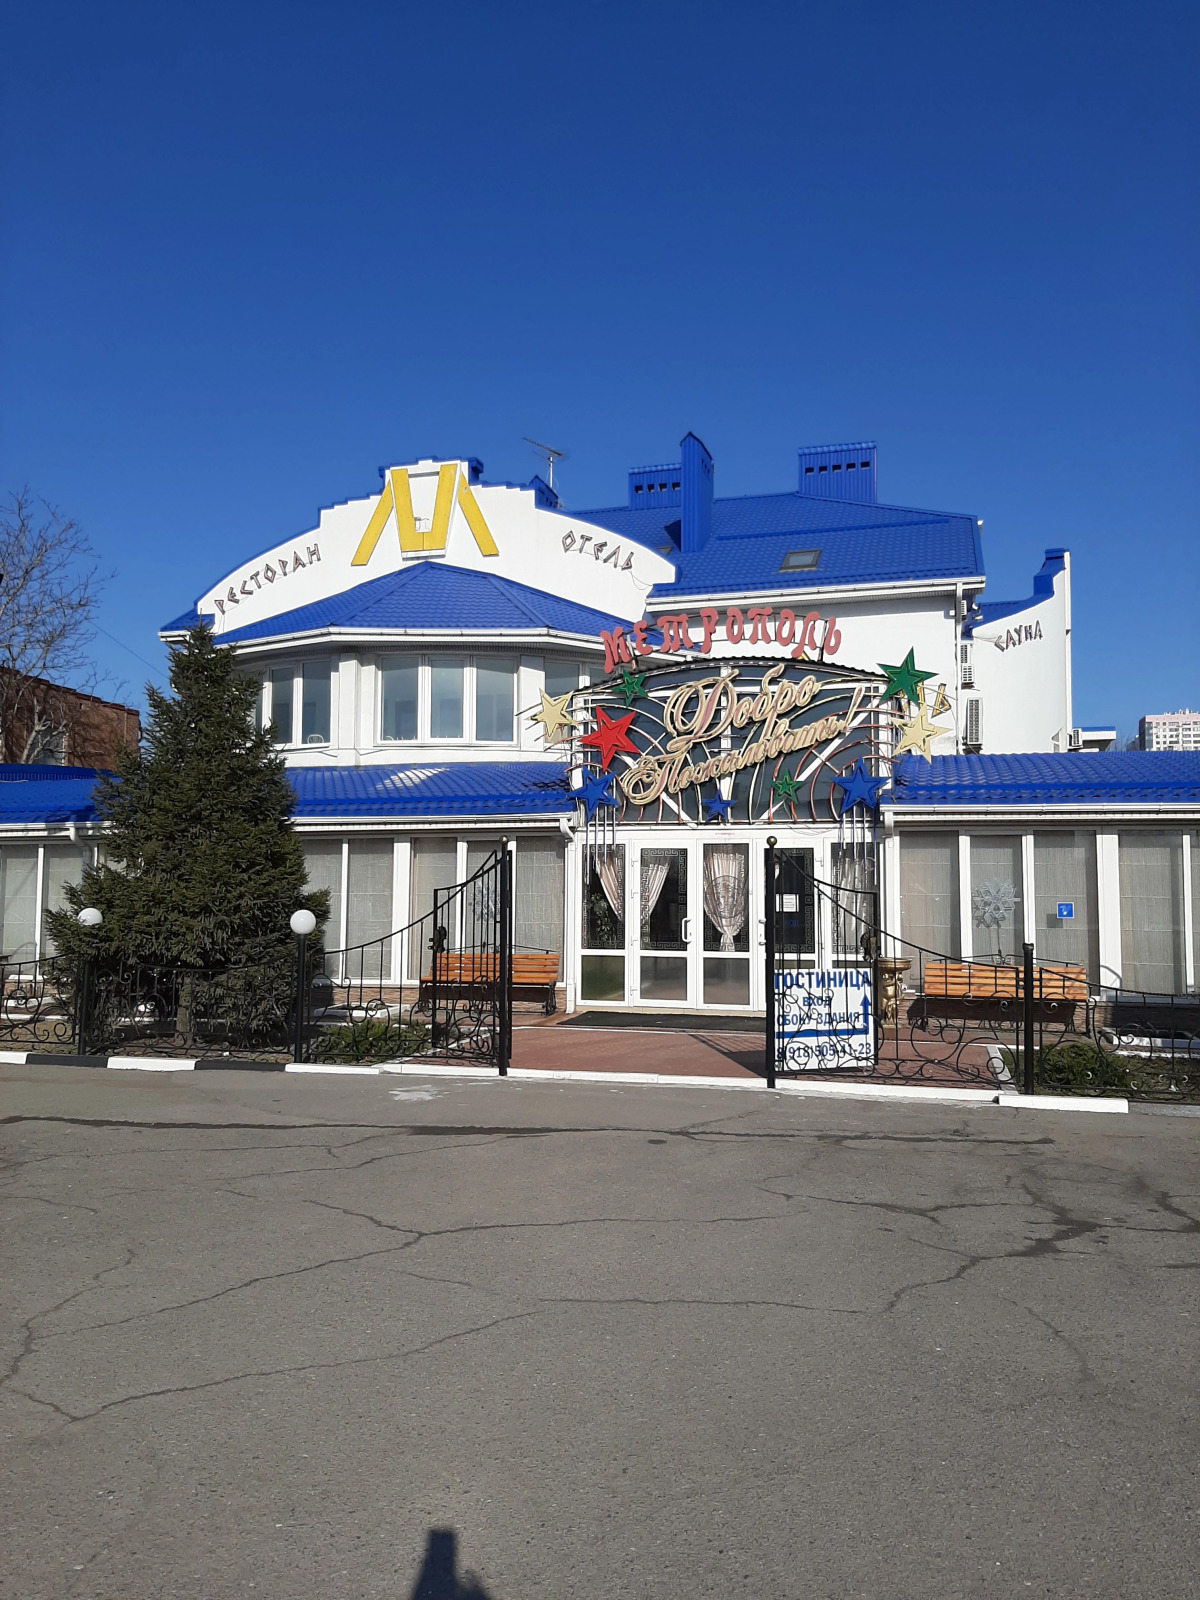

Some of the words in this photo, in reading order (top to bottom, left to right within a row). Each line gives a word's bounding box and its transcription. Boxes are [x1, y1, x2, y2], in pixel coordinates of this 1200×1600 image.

[562, 530, 634, 571] ОТЕЛЬ
[214, 543, 321, 615] РЕСТОРАН
[600, 607, 841, 674] МЕТРОПОЛЬ
[994, 620, 1043, 652] САУНА
[664, 663, 822, 752] Добро
[774, 970, 872, 990] ГОСТИНИЦА
[802, 995, 832, 1009] ВХОД
[817, 1011, 860, 1027] ЗДАНИЯ
